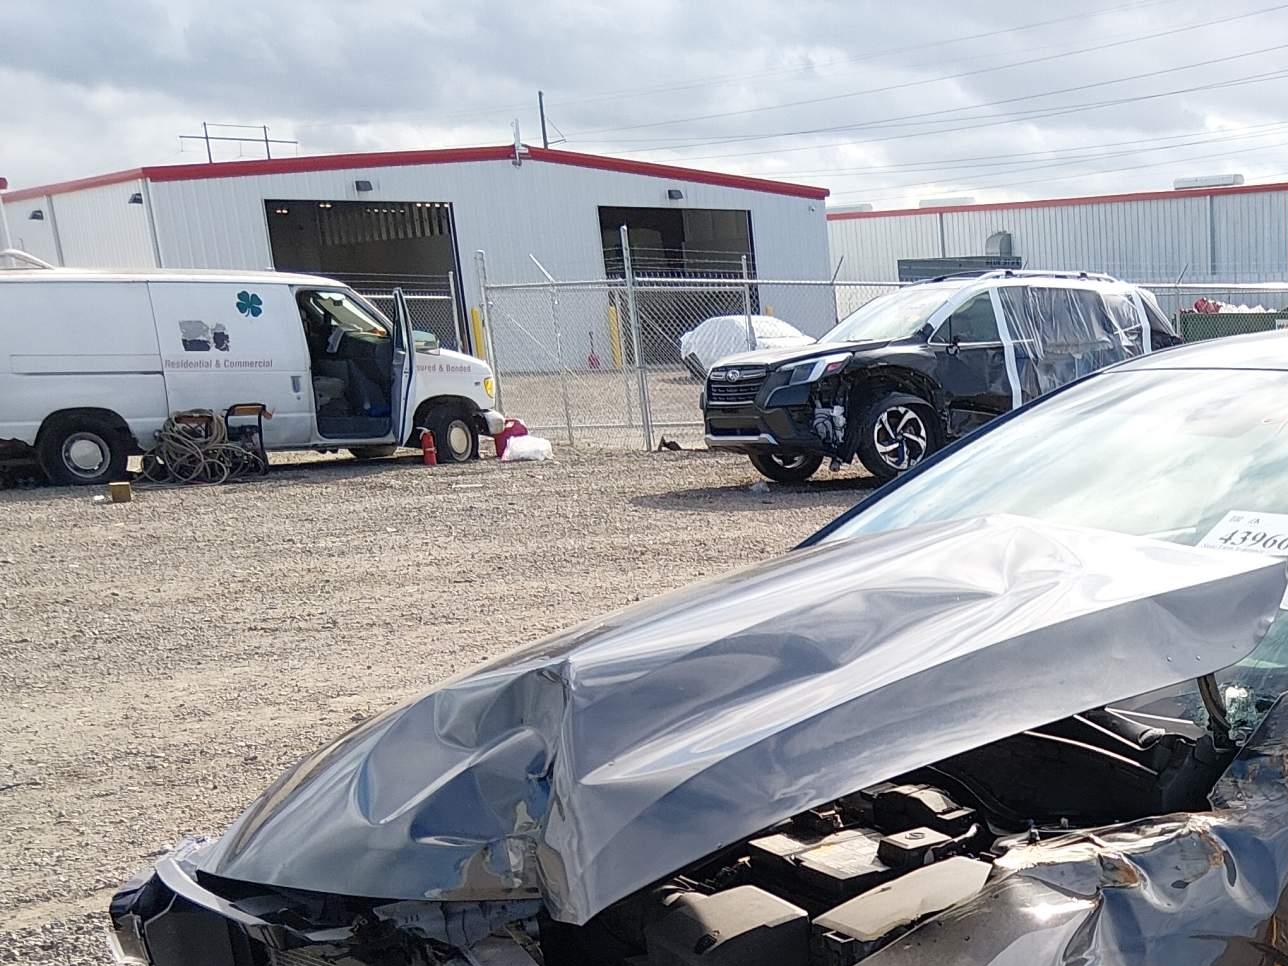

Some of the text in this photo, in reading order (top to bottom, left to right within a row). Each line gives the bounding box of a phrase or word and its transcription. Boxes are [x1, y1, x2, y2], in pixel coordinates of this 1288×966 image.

[164, 359, 273, 369] Residential & Commercial
[416, 364, 436, 372] sured
